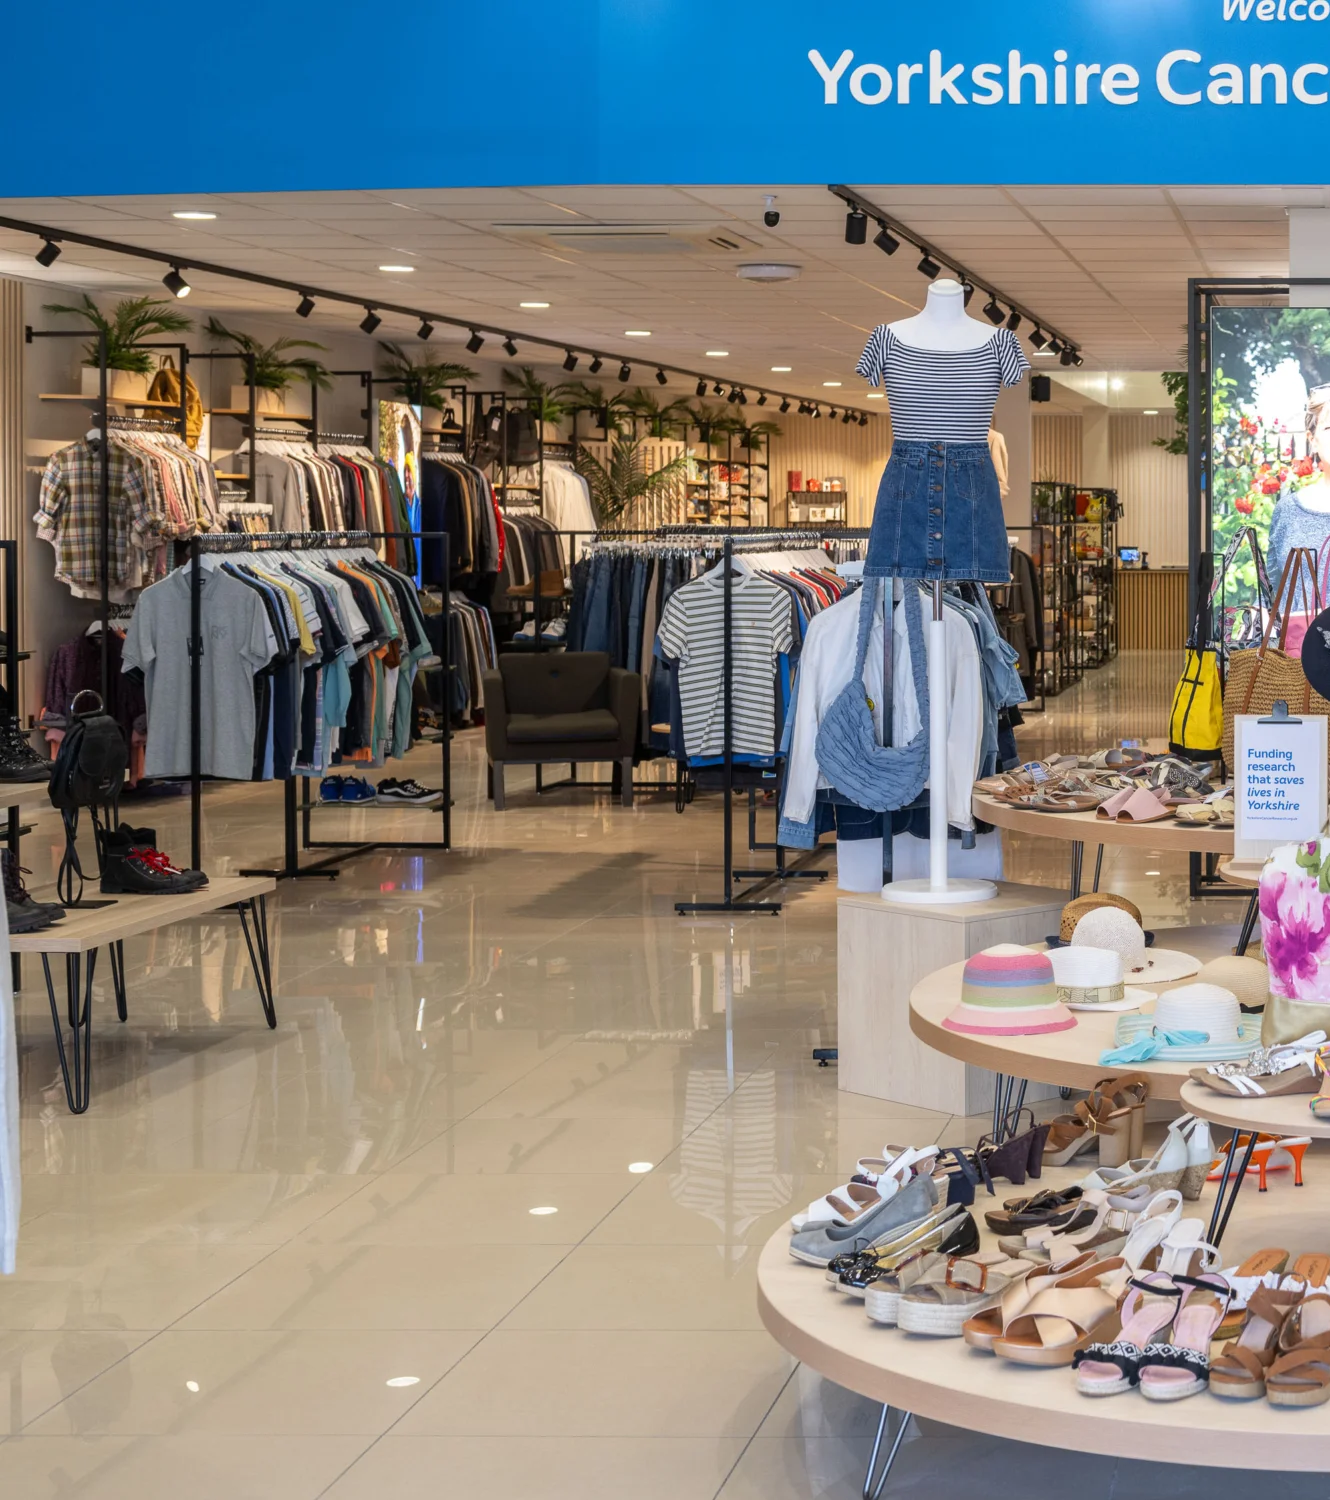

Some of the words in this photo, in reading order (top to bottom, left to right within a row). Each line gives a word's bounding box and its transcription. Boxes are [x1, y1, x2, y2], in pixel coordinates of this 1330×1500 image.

[808, 49, 1140, 105] Yorkshire
[1247, 748, 1293, 761] Funding
[1247, 761, 1296, 772] research
[1247, 774, 1271, 785] that
[1273, 776, 1305, 785] saves
[1247, 787, 1272, 798] lives
[1274, 787, 1286, 798] in
[1247, 800, 1300, 811] Yorkshire
